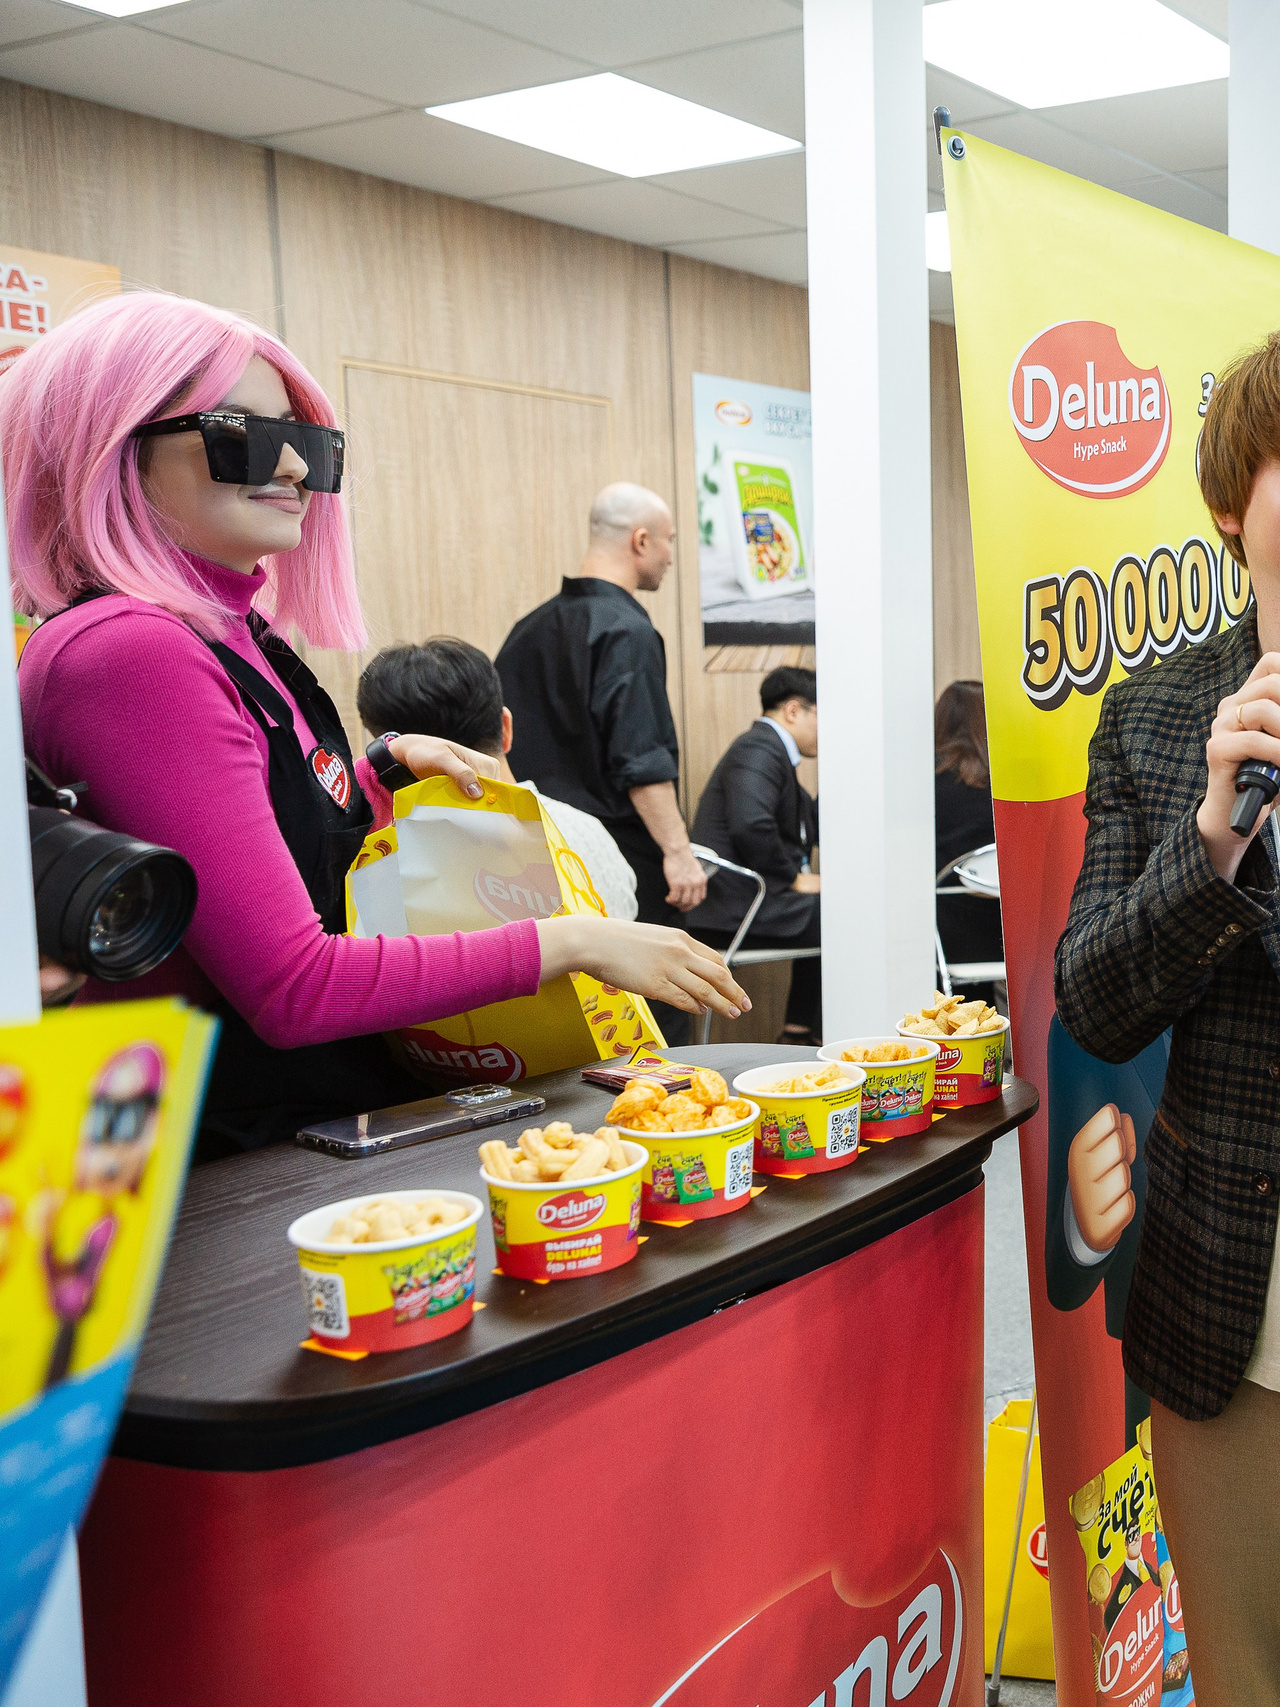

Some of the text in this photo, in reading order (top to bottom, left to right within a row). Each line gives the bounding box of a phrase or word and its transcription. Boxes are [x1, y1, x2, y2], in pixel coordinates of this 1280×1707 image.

[0, 267, 43, 292] А-
[1015, 361, 1162, 442] Deluna
[1073, 435, 1127, 462] Hype Snack
[1021, 566, 1112, 711] 50
[540, 1195, 604, 1223] Deluna
[1113, 1464, 1139, 1508] мой
